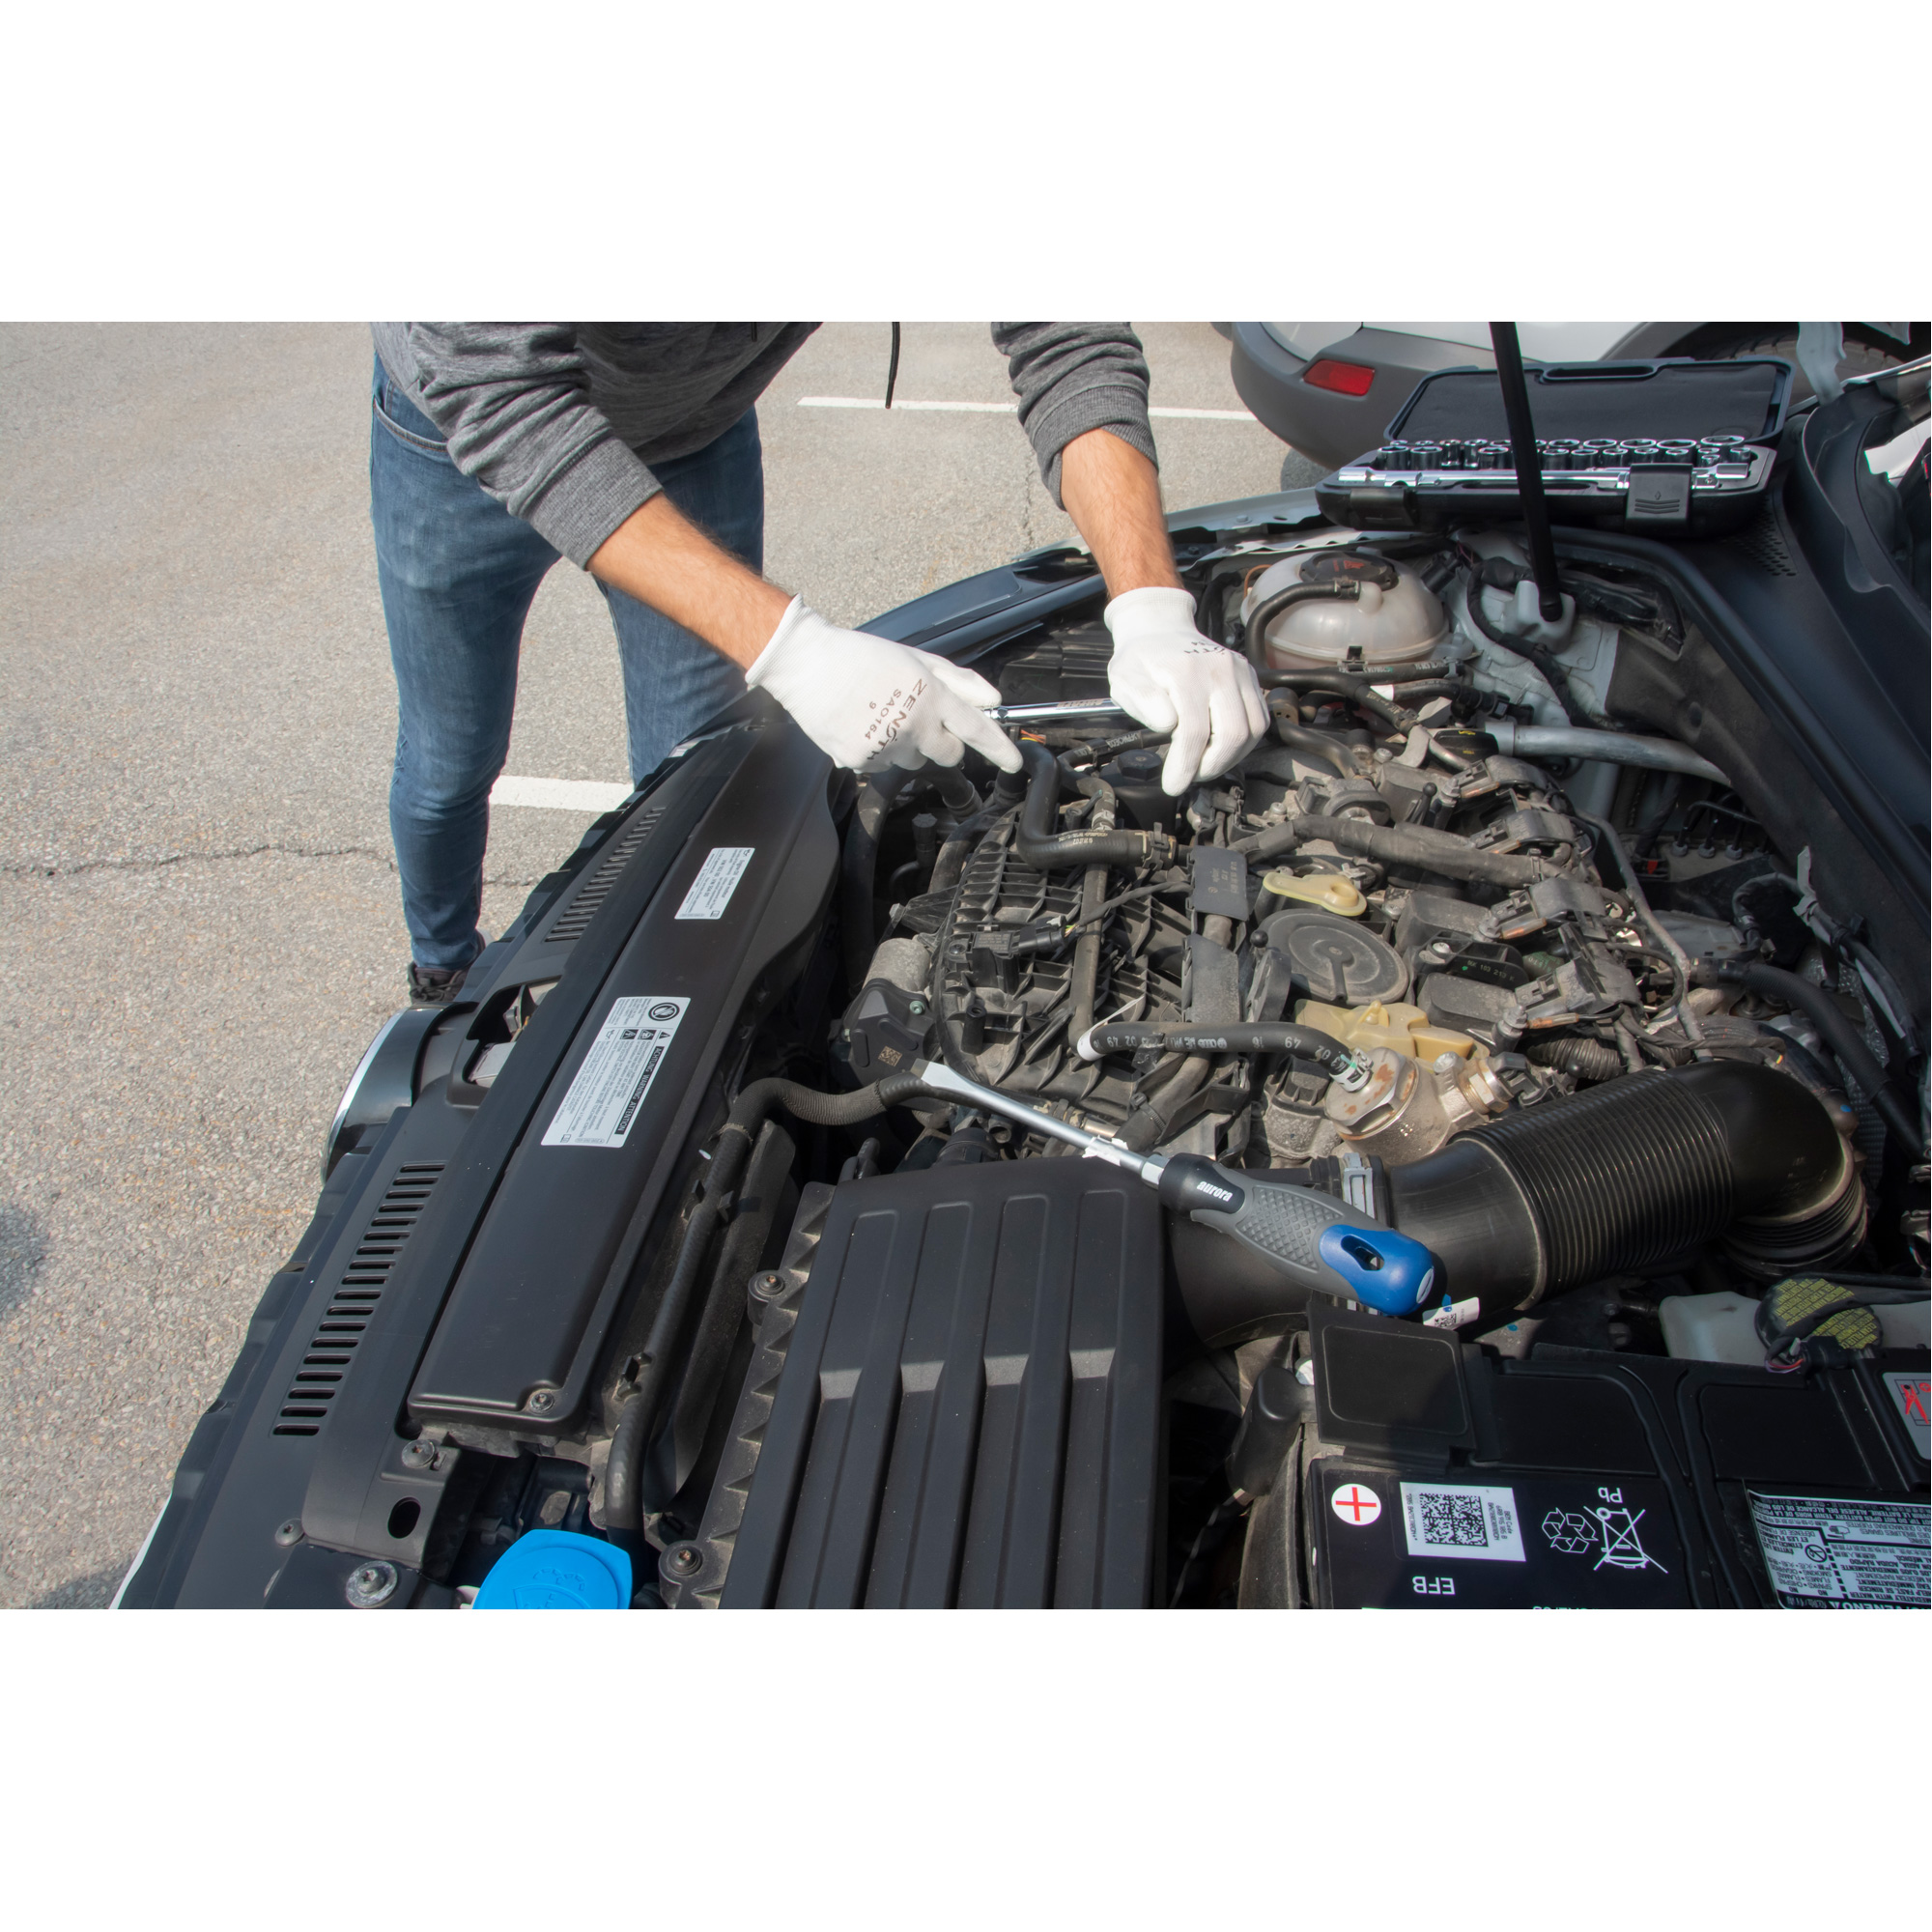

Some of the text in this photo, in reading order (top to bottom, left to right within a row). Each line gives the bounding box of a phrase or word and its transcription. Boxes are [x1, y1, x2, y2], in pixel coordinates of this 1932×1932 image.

[1284, 1037, 1301, 1049] 49
[644, 1047, 663, 1072] ACHTUNG
[631, 1074, 650, 1099] WARNING
[616, 1100, 638, 1131] ATTENTION
[1197, 1180, 1234, 1203] aurora
[1598, 1487, 1623, 1503] Pb
[1412, 1576, 1455, 1595] EFB
